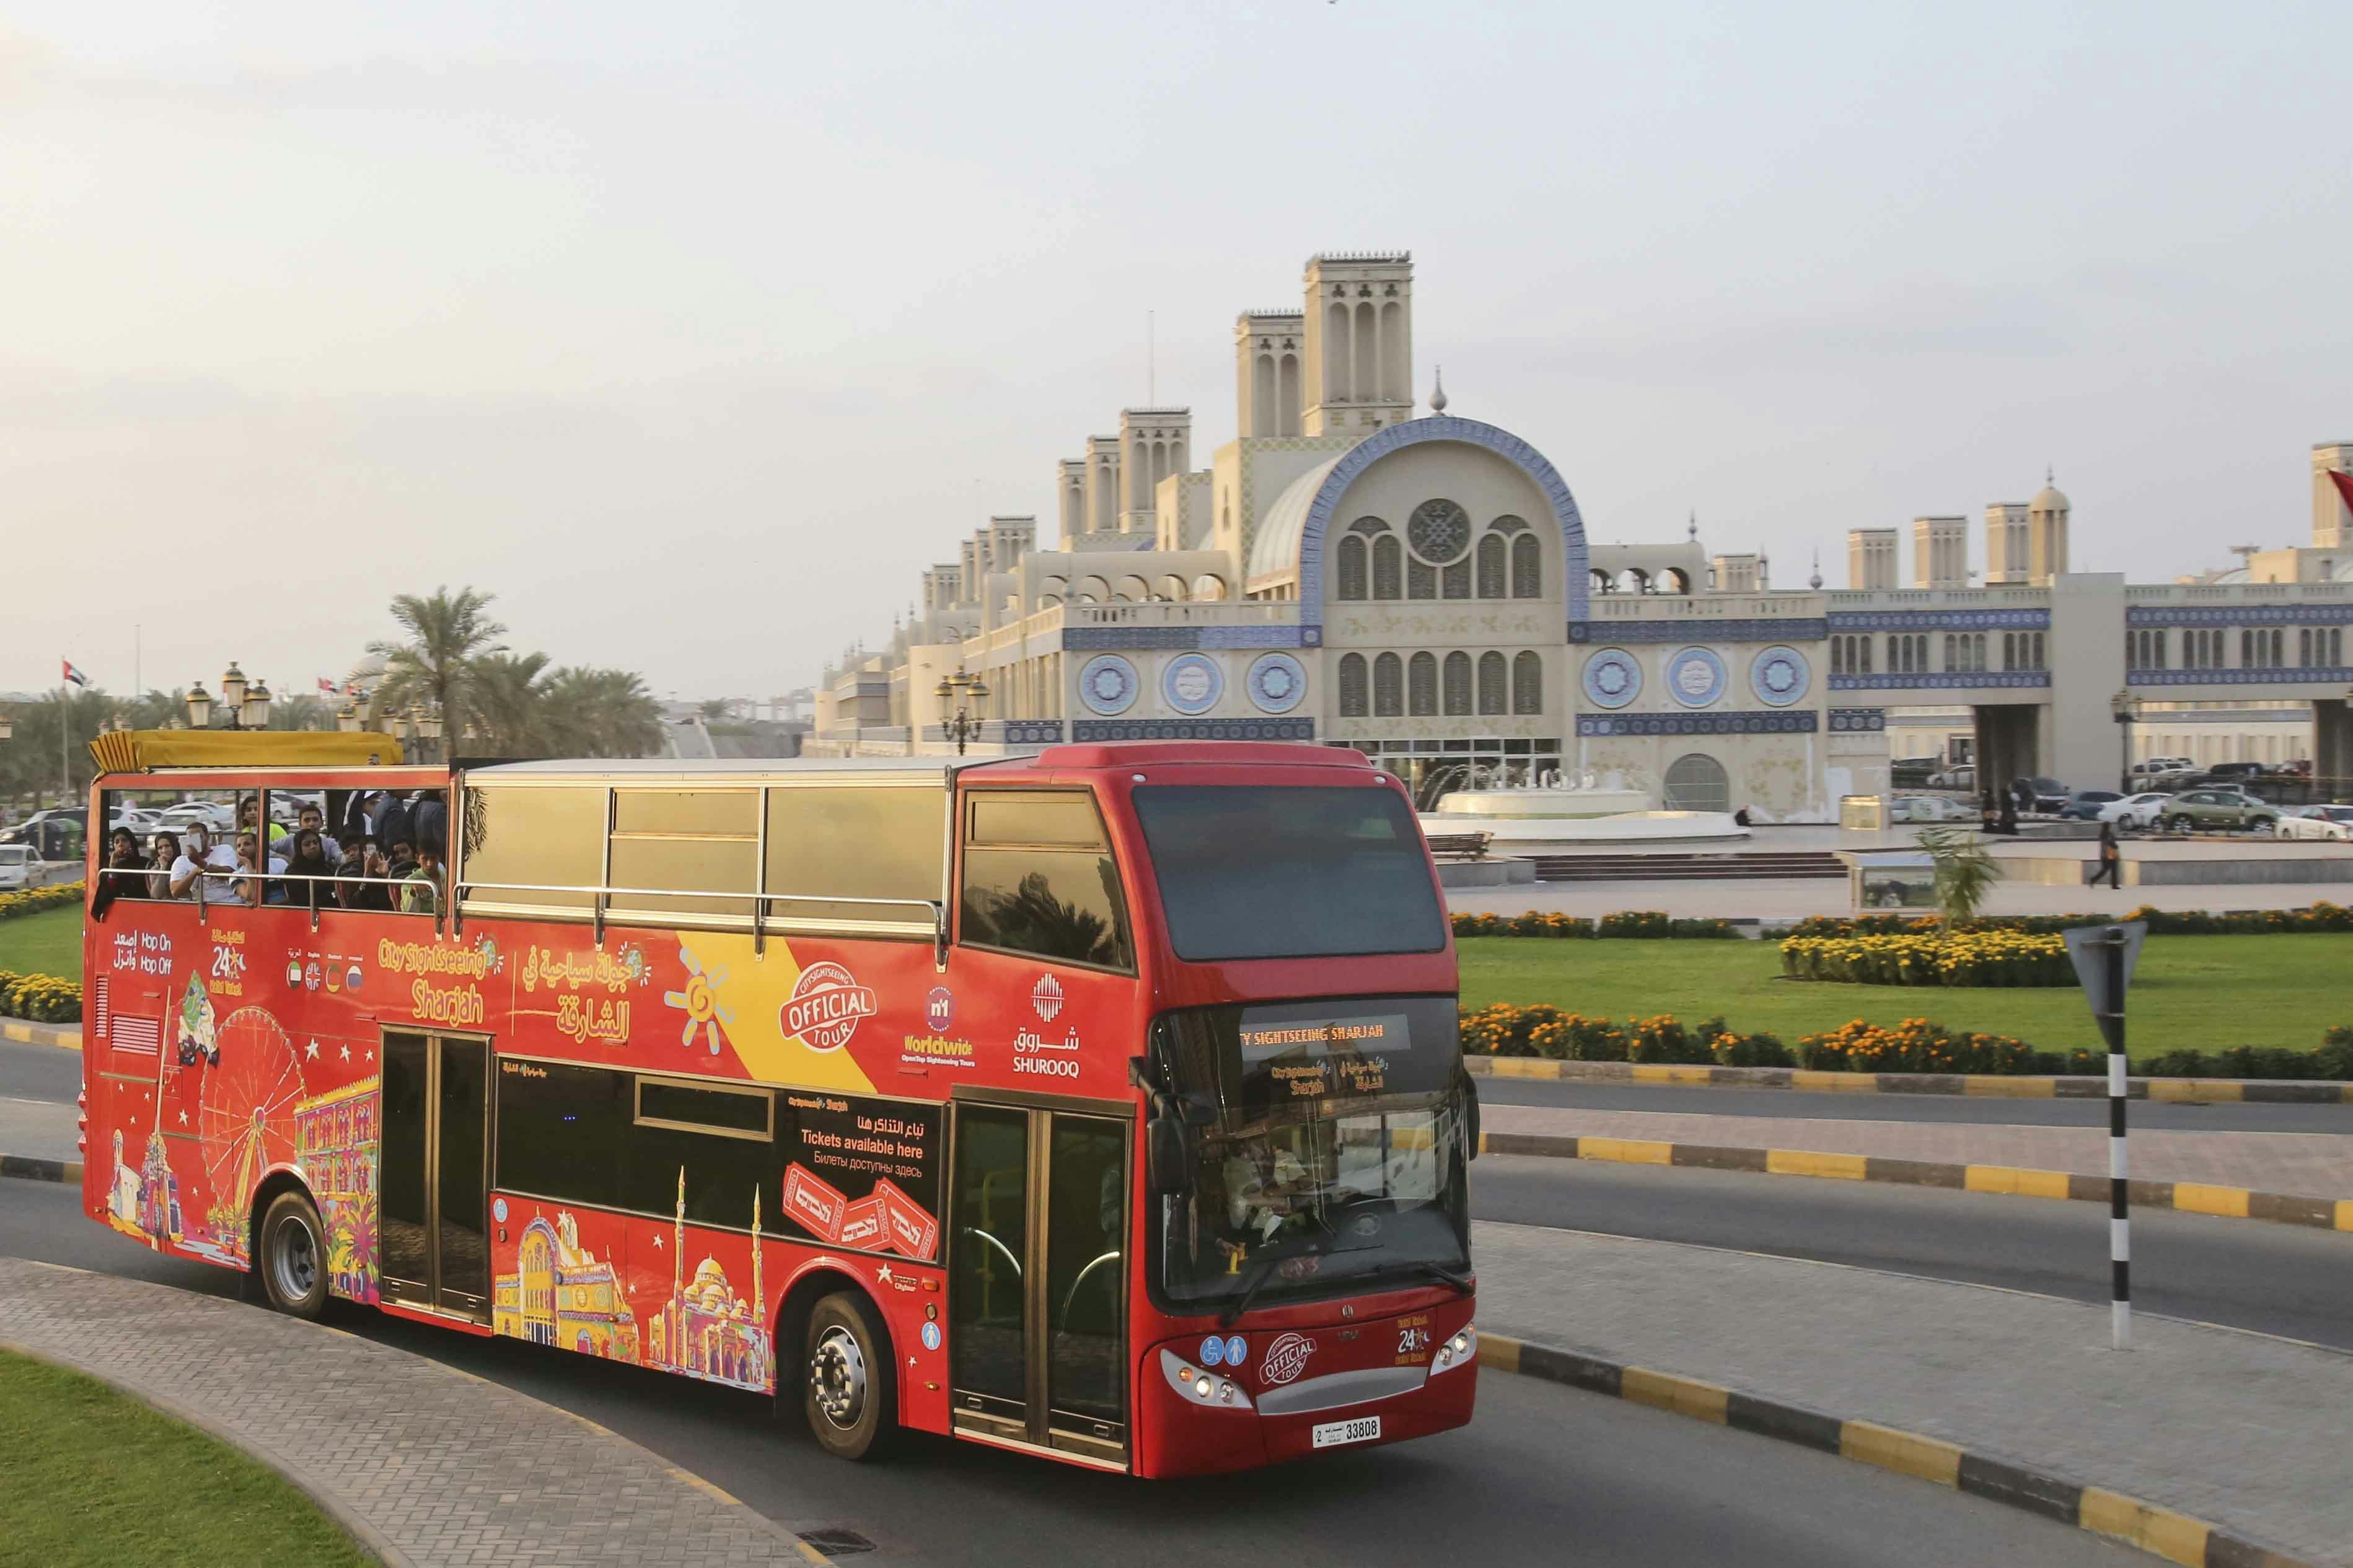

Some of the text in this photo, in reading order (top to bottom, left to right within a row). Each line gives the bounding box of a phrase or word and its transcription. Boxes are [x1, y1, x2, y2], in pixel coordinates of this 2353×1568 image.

[141, 932, 171, 952] Hop On
[140, 955, 172, 975] Hop Off
[522, 945, 633, 993] جولة سياحية في
[412, 978, 484, 1028] Sharjah
[789, 991, 871, 1031] OFFICIAL
[556, 994, 630, 1044] الشارقة
[814, 1022, 850, 1046] TOUR
[905, 1035, 972, 1056] Worldwide
[1254, 1028, 1329, 1045] SIGHTSEEING
[1332, 1025, 1383, 1040] SHARJAH
[1013, 1056, 1080, 1079] SHUROOQ
[857, 1115, 872, 1130] هنا
[873, 1119, 903, 1134] التذاكر
[801, 1129, 923, 1159] Tickets available here
[814, 1150, 922, 1178] Билеты доступны здесь
[1265, 1341, 1313, 1378] OFFICIAL
[1282, 1360, 1303, 1380] TOUR
[1346, 1420, 1378, 1440] 33808
